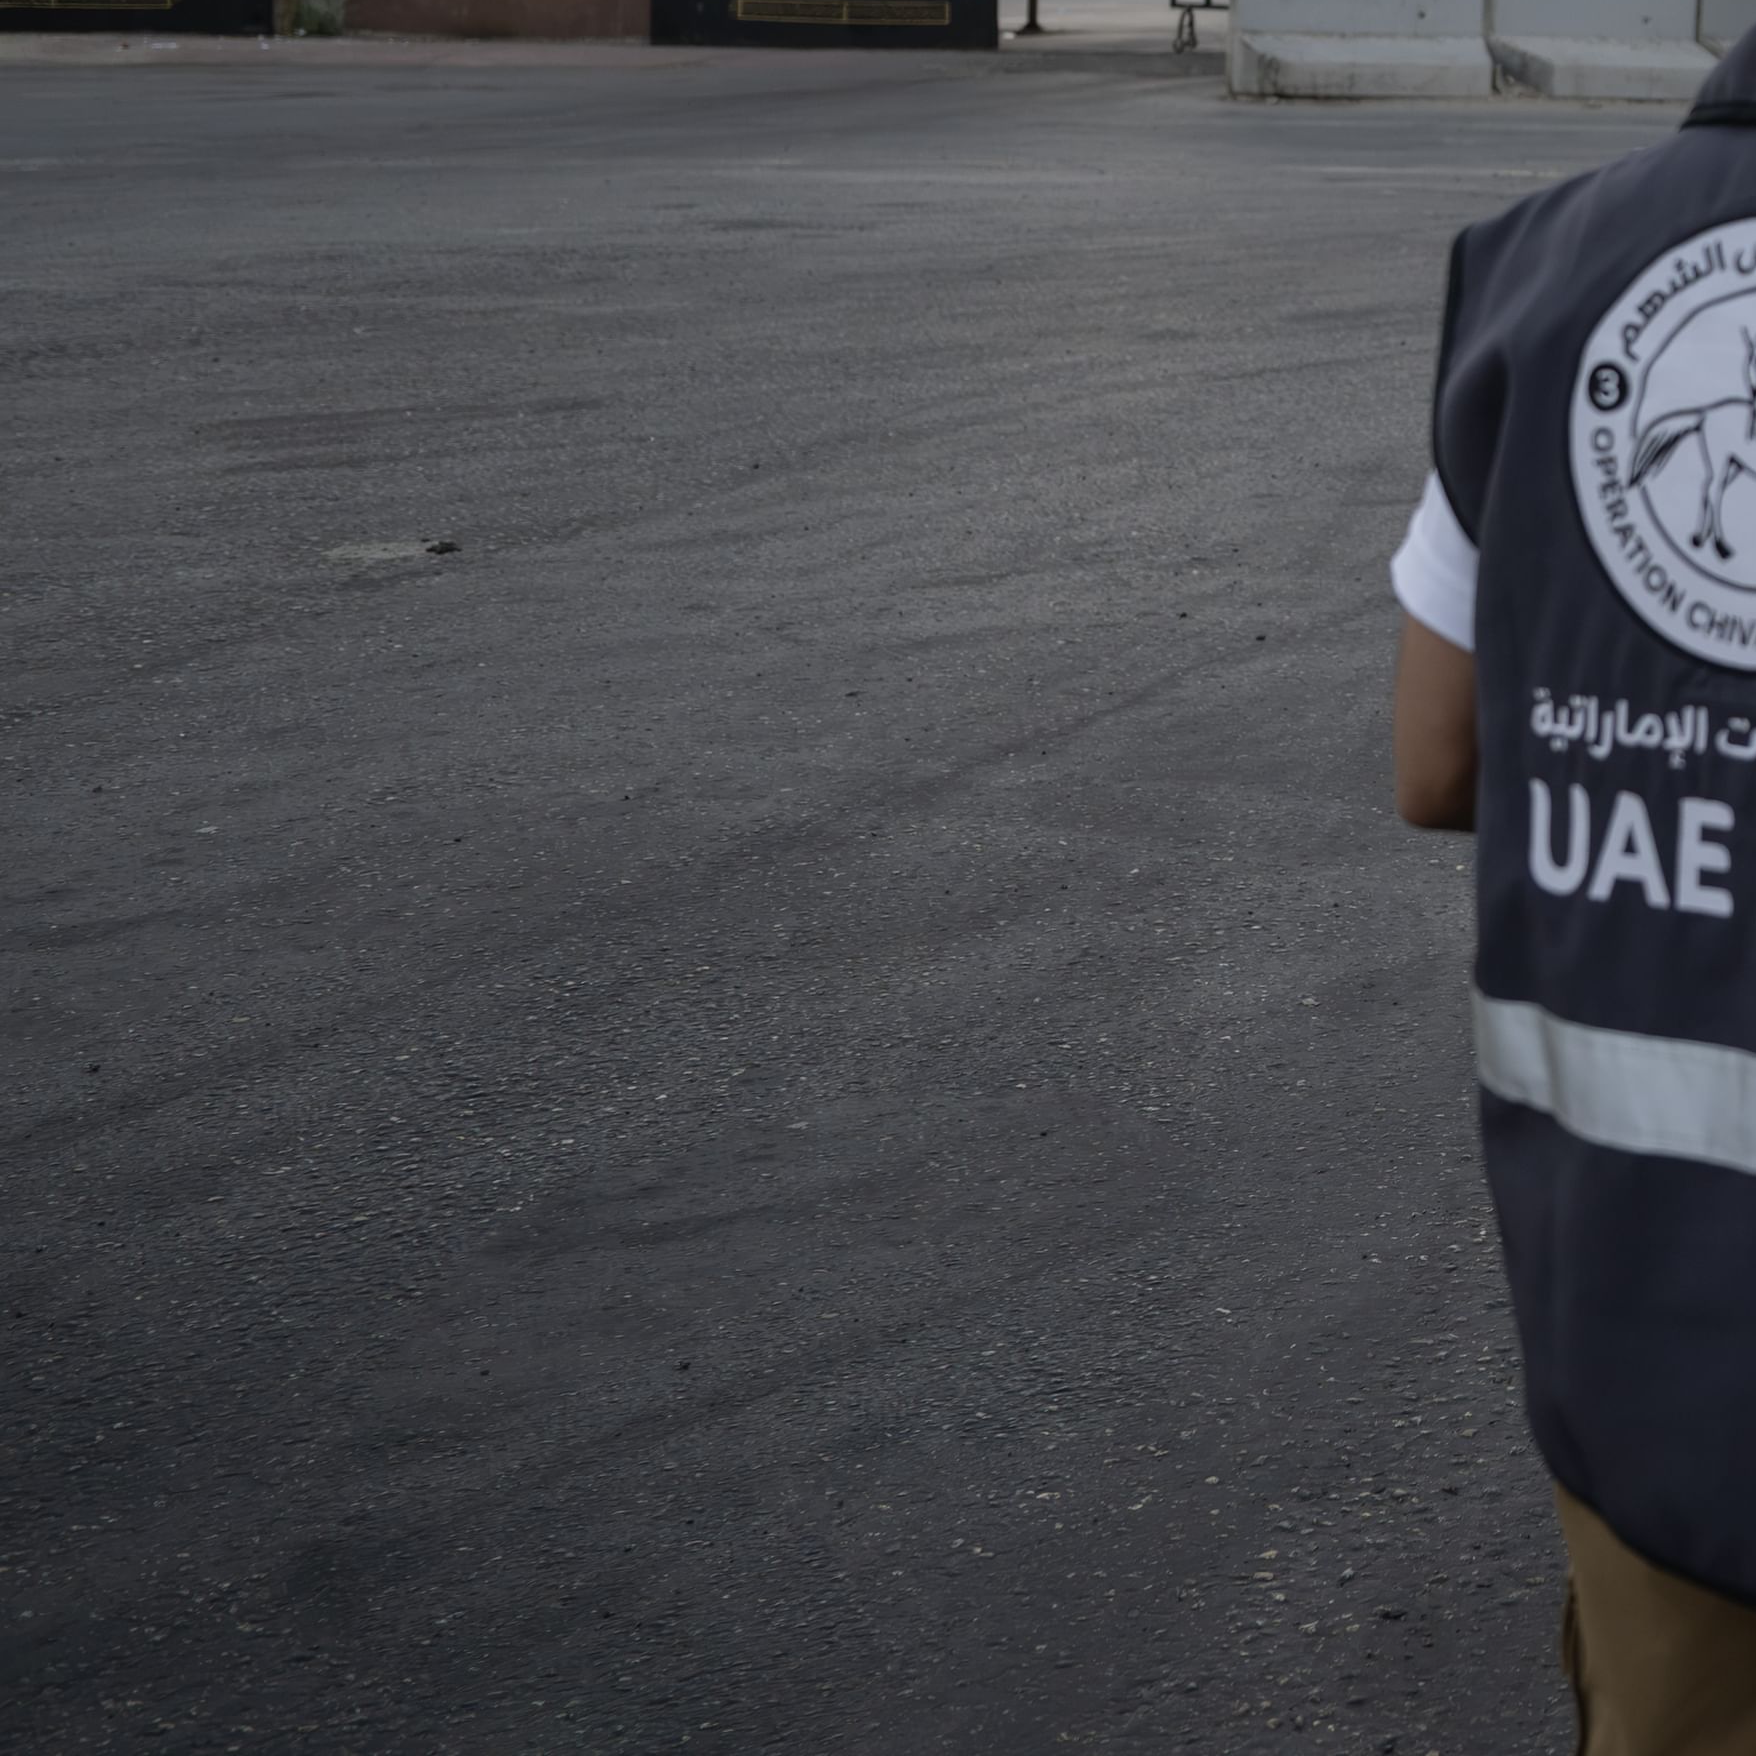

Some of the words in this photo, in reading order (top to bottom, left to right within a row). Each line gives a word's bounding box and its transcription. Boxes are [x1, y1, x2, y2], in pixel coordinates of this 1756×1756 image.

[1621, 240, 1726, 364] الشهم
[1596, 367, 1620, 402] 3
[1591, 426, 1686, 613] OPERATION
[1530, 688, 1708, 770] الإماراتية
[1529, 778, 1735, 918] UAE
